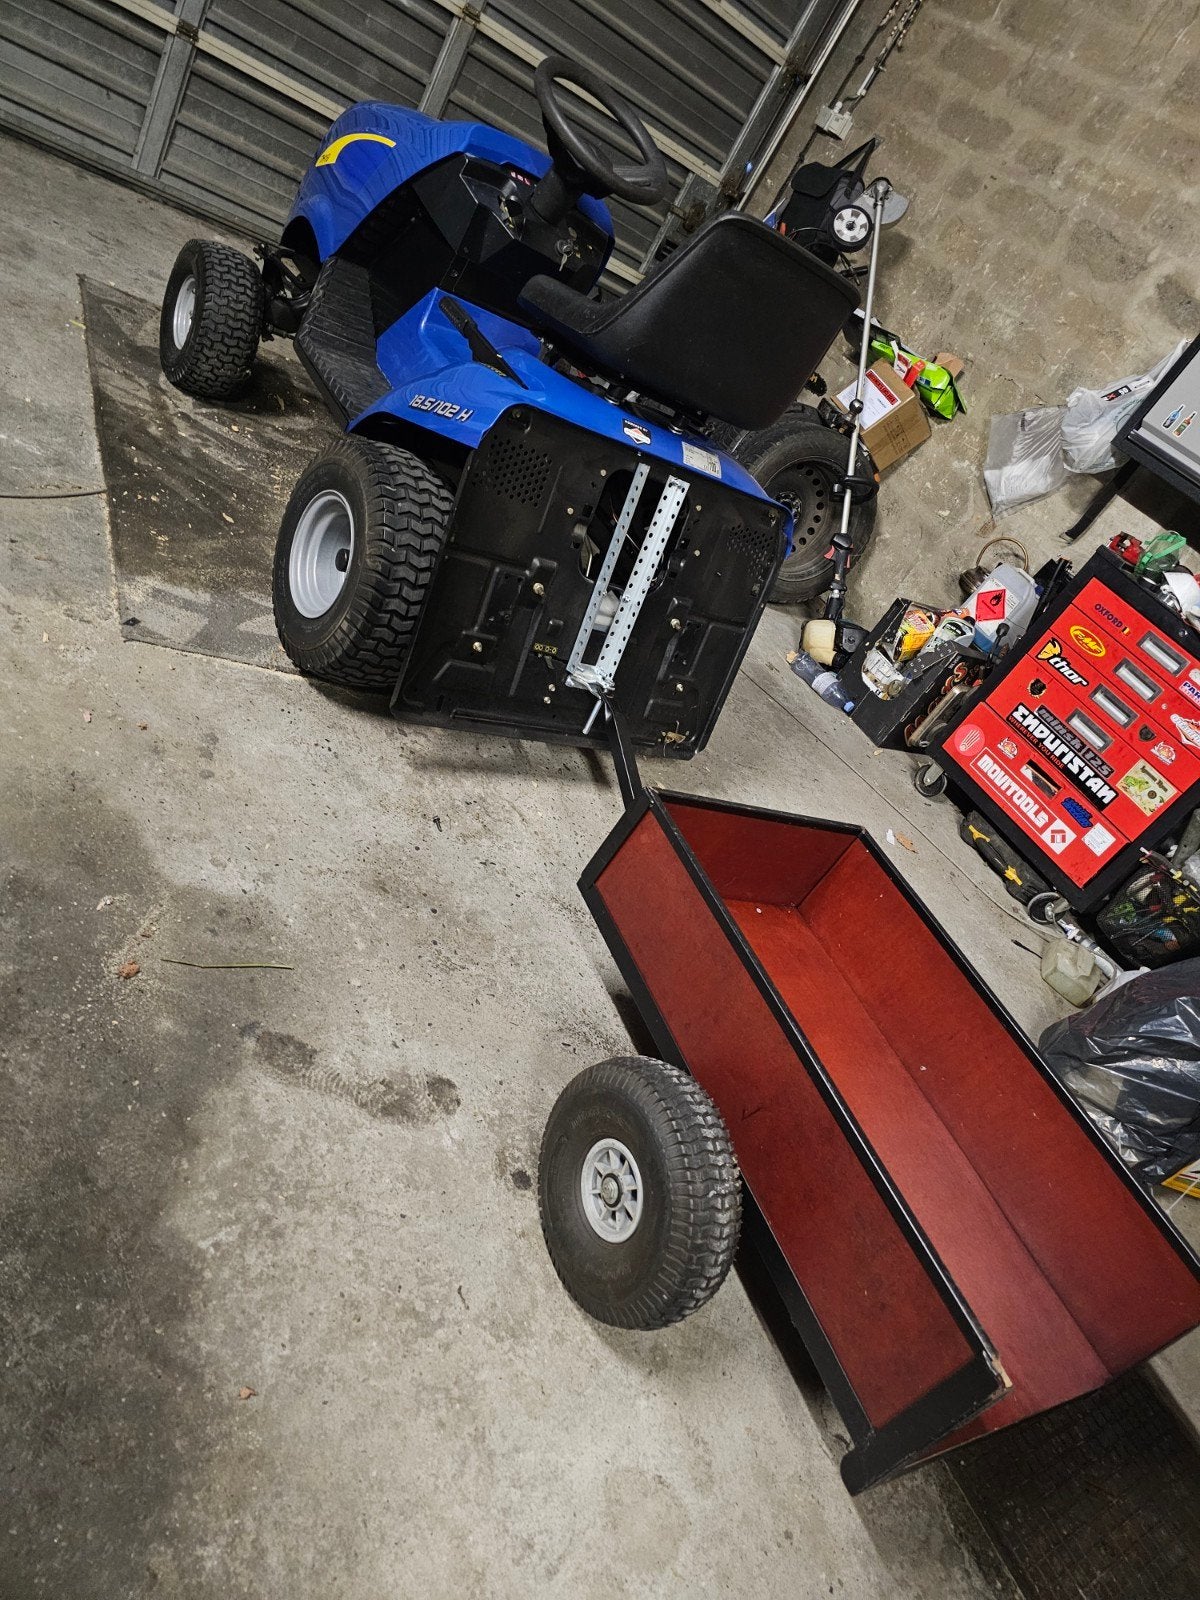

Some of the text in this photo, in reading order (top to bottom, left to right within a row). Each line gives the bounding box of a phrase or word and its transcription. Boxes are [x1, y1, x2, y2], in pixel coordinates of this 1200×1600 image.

[409, 394, 474, 422] 18.5/102 H
[1094, 603, 1123, 628] OXFORD
[1048, 656, 1088, 686] thor
[1008, 715, 1065, 770] WHEREVER YOU RIDE
[1083, 749, 1112, 776] 125
[977, 754, 1049, 829] MOVITOOLS
